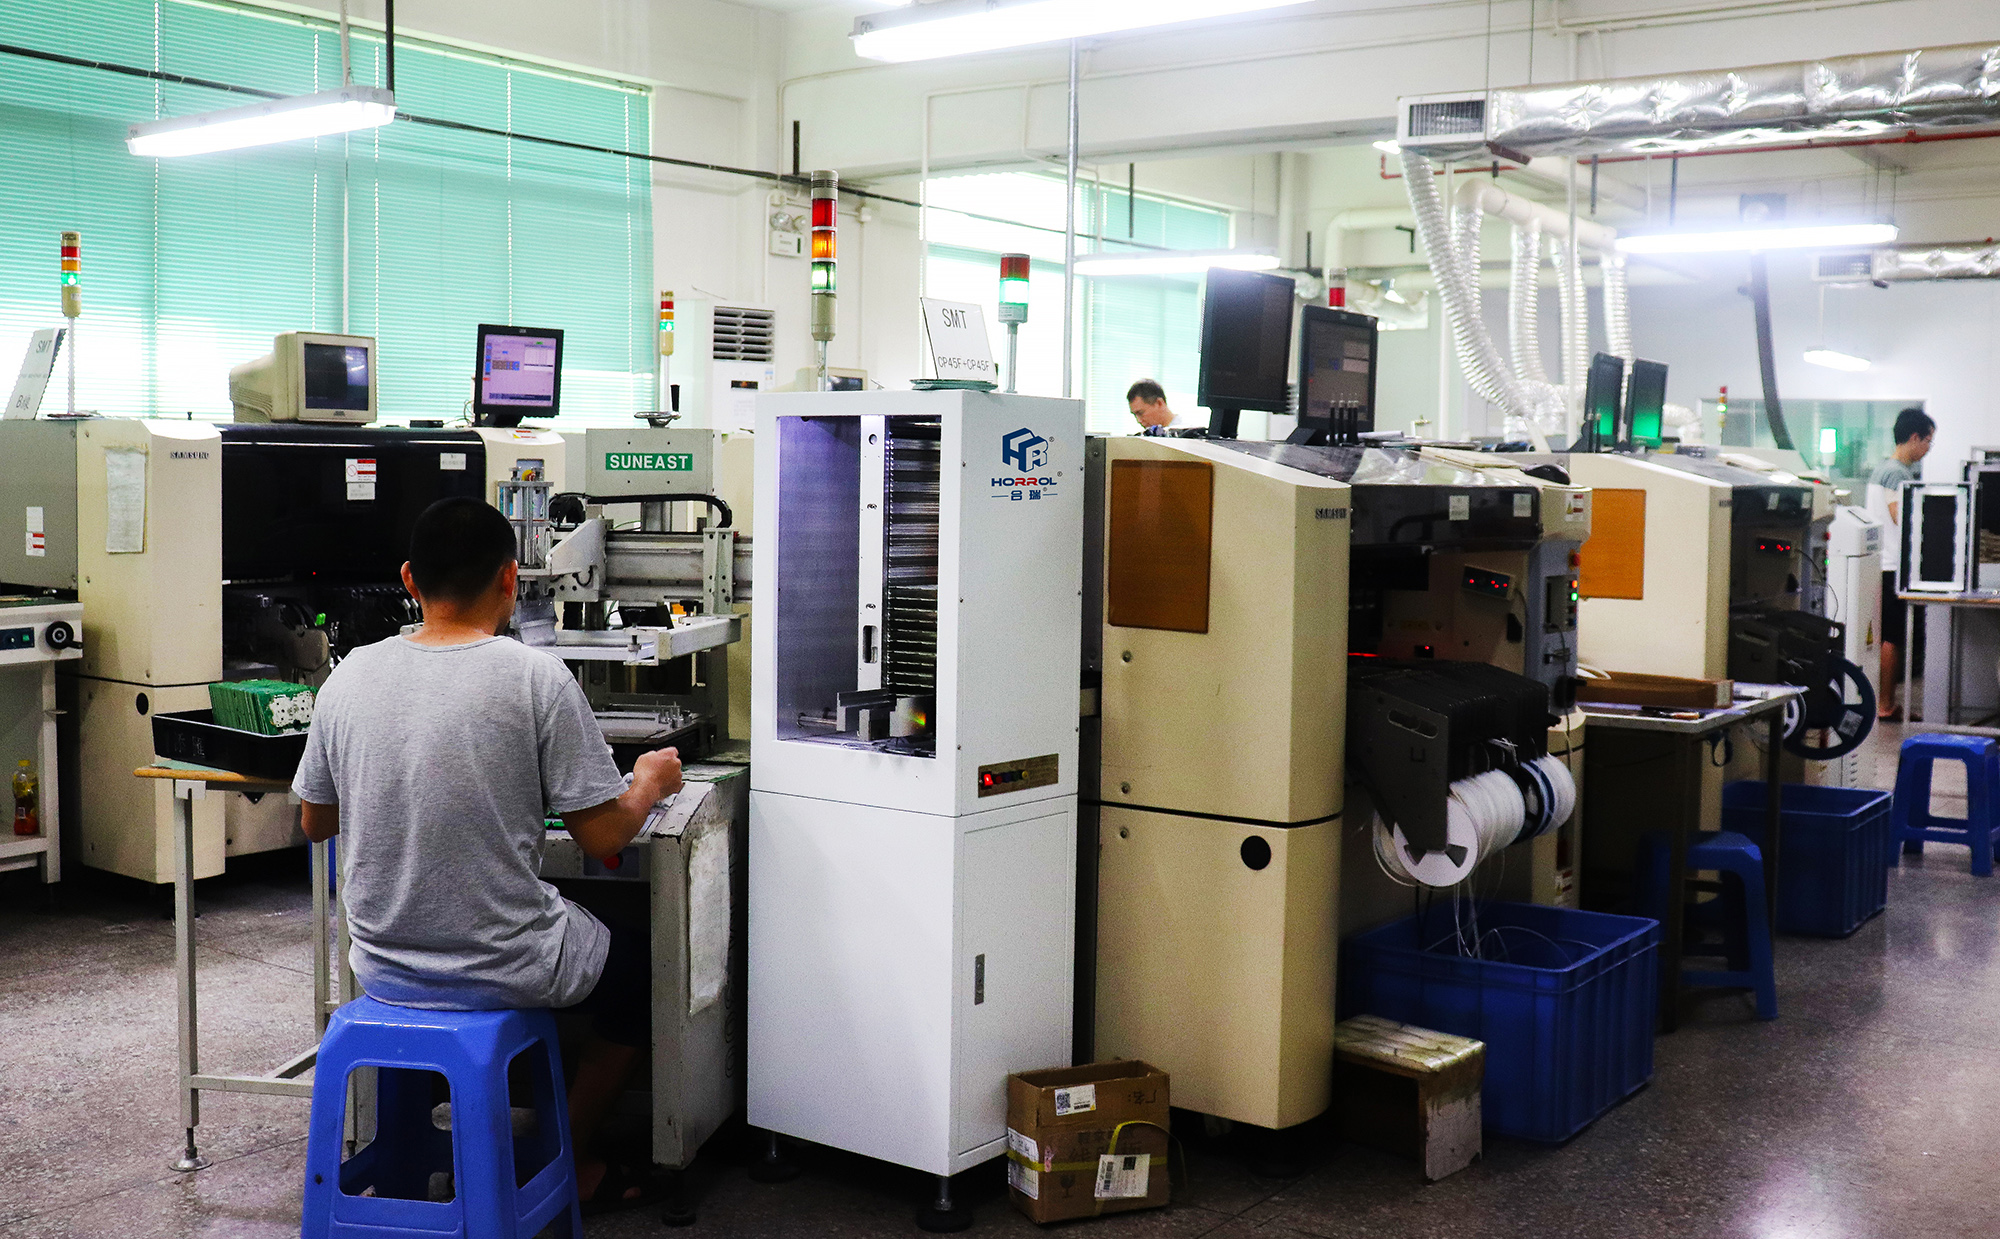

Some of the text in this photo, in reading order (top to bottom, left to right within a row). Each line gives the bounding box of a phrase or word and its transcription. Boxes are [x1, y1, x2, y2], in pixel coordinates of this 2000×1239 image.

[942, 308, 967, 329] SMT
[35, 340, 52, 354] SMT
[609, 454, 689, 469] SUNEAST
[991, 477, 1058, 487] HORROL
